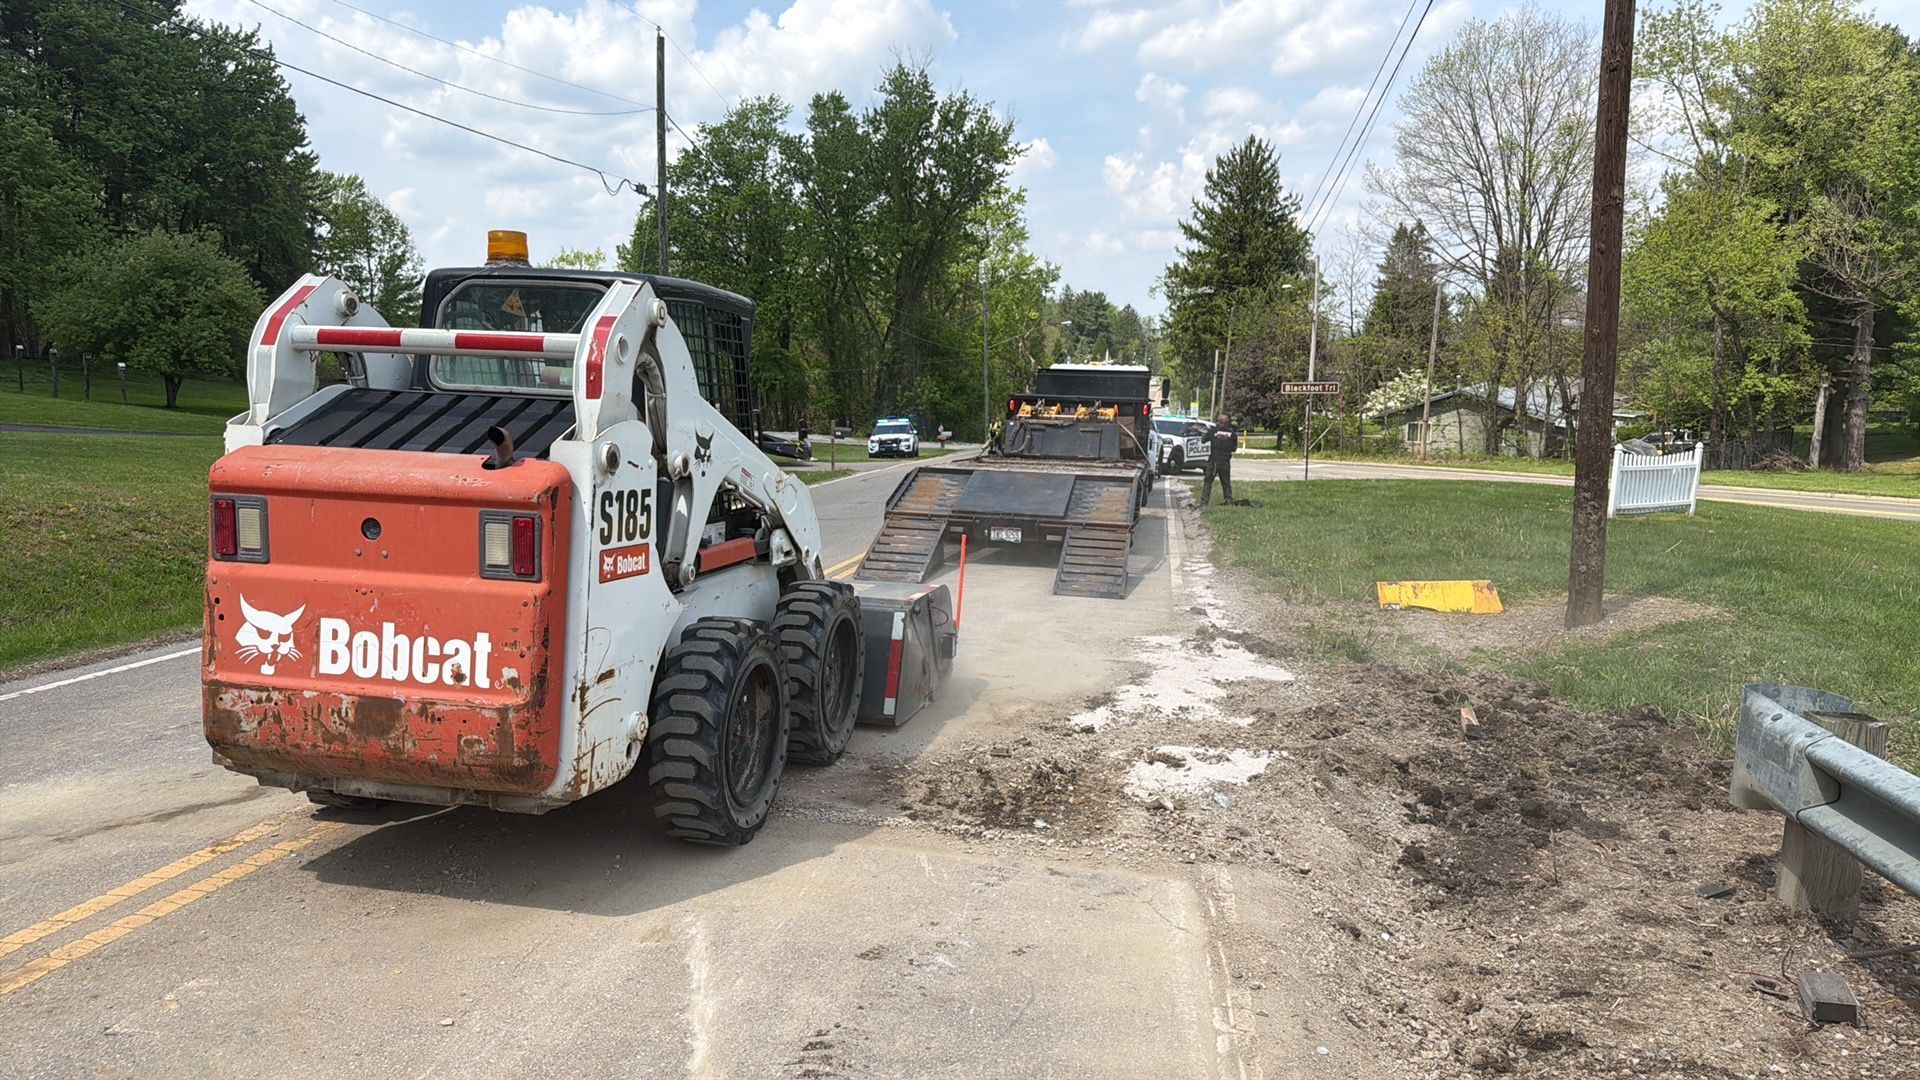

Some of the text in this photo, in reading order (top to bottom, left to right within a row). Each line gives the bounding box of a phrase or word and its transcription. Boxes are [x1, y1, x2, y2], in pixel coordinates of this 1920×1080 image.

[1285, 384, 1336, 392] Blackfoot Trl
[1189, 446, 1210, 454] POLICE
[600, 488, 651, 545] S185
[617, 553, 646, 574] Bobcat
[319, 617, 491, 688] Bobcat
